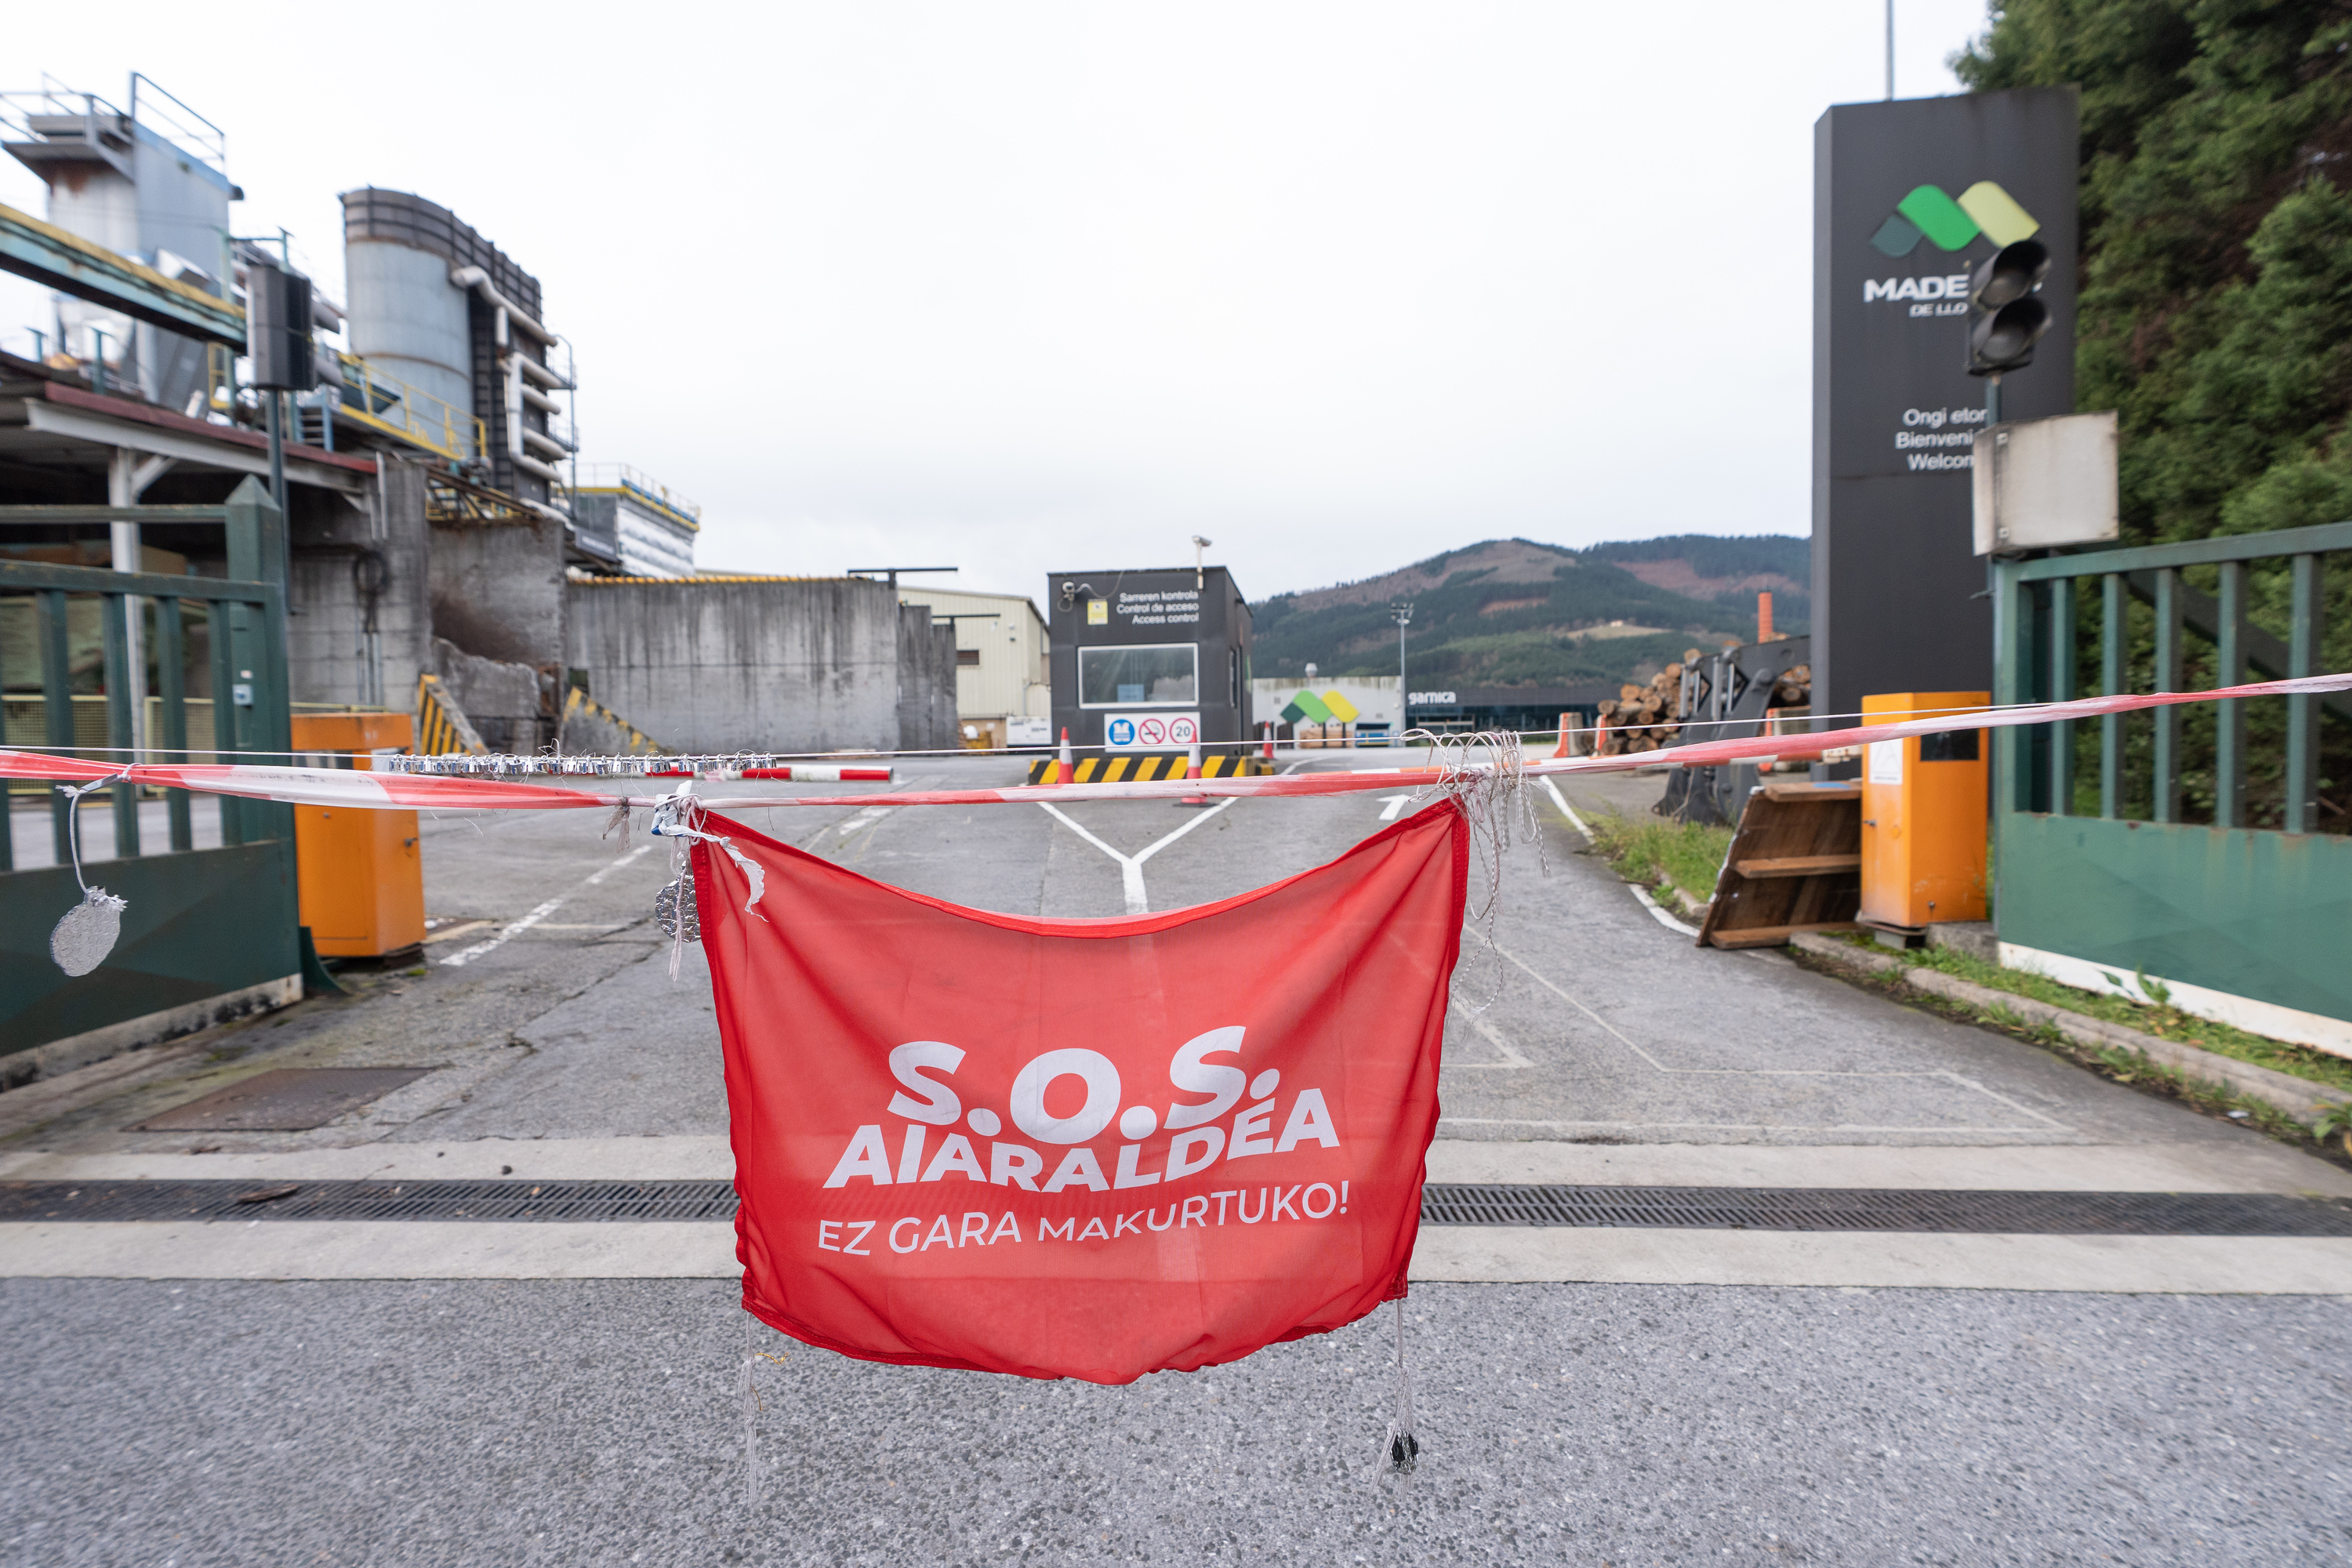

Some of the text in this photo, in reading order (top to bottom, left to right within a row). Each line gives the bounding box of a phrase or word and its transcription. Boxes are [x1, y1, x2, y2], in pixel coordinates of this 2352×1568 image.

[1863, 274, 1969, 303] MADE
[1909, 302, 1969, 318] DE LLO
[1903, 407, 1988, 429] Ongi etor
[1120, 590, 1199, 602] Sarreren kontrola
[1116, 603, 1199, 614] Control de acceso
[1132, 612, 1199, 624] Access control
[1407, 691, 1457, 706] garnica
[1175, 726, 1191, 737] 20
[887, 1025, 1280, 1145] S.O.S.
[823, 1088, 1340, 1192] AIARALDEA
[818, 1180, 1349, 1256] EZ GARA MAKURTUKO!
